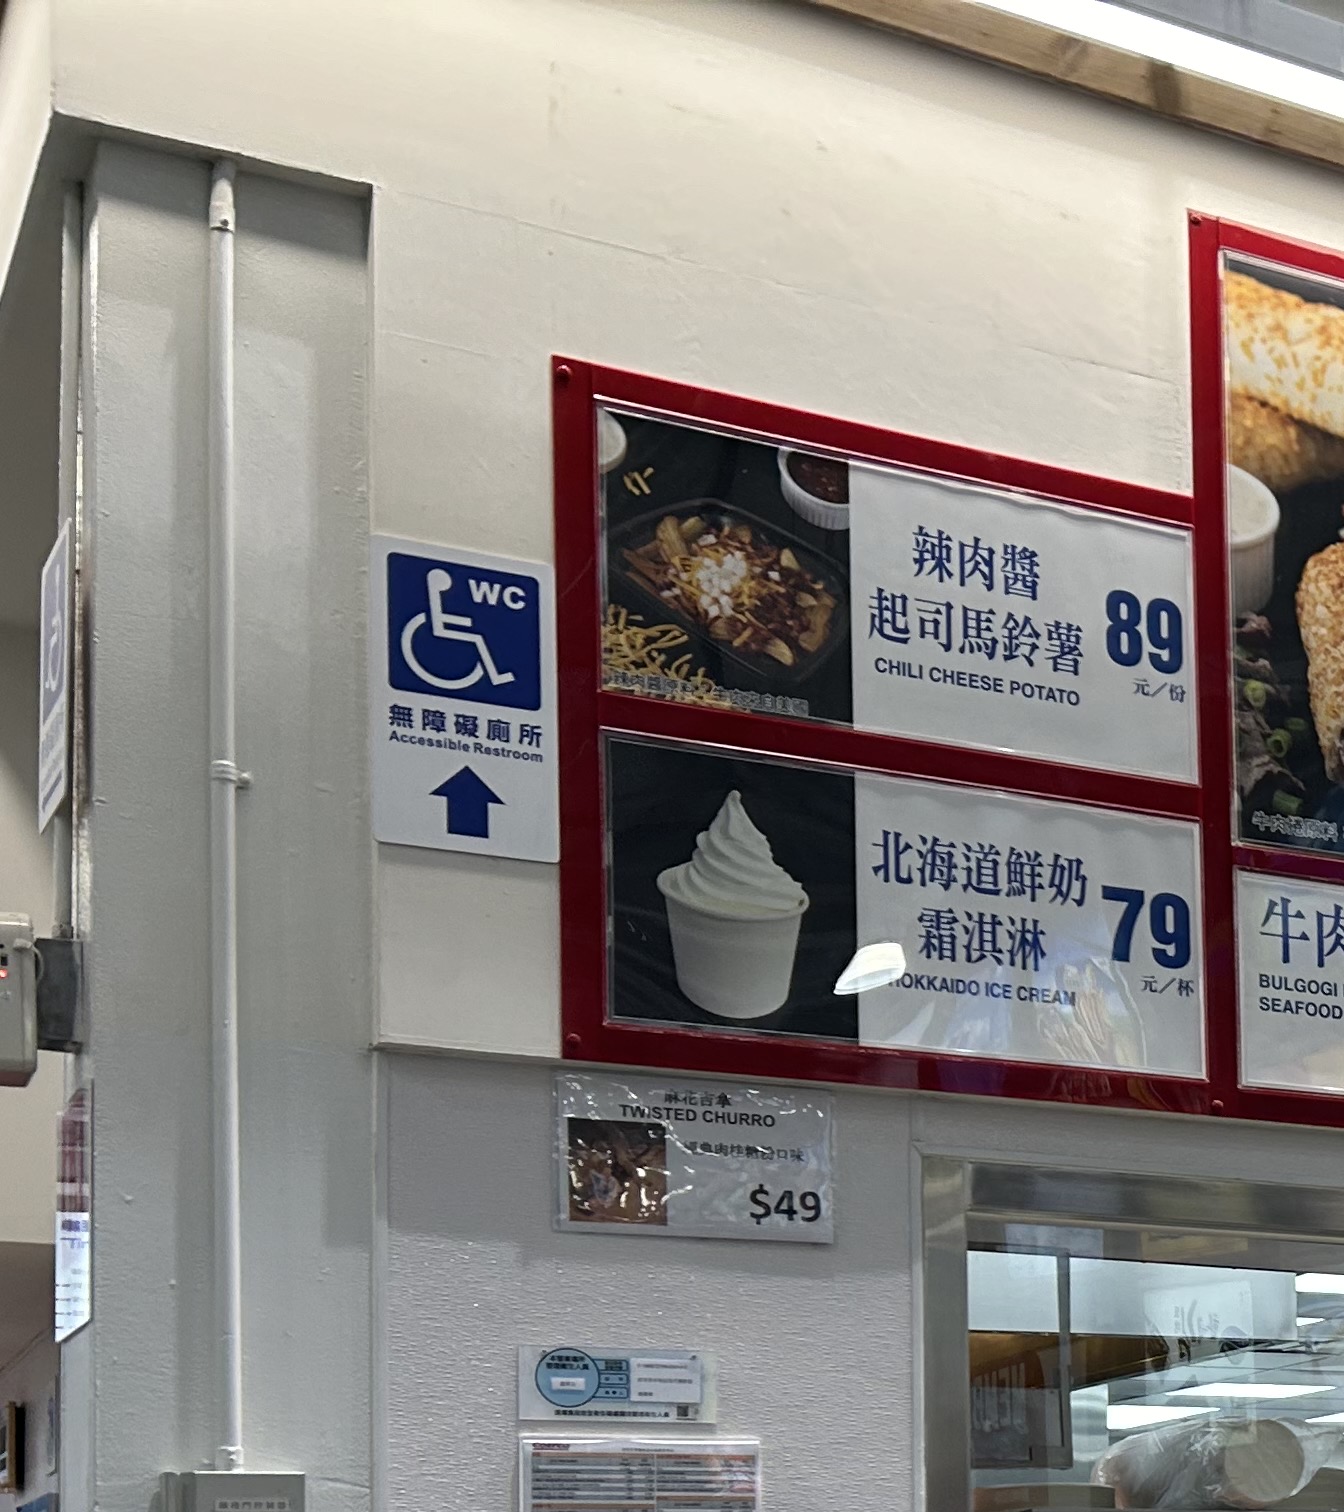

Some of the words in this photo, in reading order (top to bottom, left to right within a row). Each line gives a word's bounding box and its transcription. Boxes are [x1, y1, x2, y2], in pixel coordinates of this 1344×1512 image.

[912, 525, 1040, 601] 辣肉醬
[468, 579, 527, 610] WC
[868, 586, 1084, 677] 起司馬鈴薯
[1105, 590, 1184, 675] 89
[874, 657, 923, 680] CHILI
[929, 666, 1004, 694] CHEESE
[1010, 681, 1080, 706] POTATO
[389, 703, 542, 748] 無障礙廁所
[389, 730, 470, 752] Accessible
[473, 742, 543, 763] Restroom
[871, 829, 1088, 908] 北海道鮮奶
[917, 906, 1047, 973] 霜淇淋
[1101, 885, 1192, 970] 79
[985, 982, 1012, 1000] ICE
[1016, 986, 1076, 1007] CREAM
[1259, 973, 1338, 996] BULGOGI
[1259, 996, 1343, 1020] SEAFOOD
[619, 1104, 697, 1122] TWISTED
[702, 1110, 776, 1128] CHURRO
[750, 1184, 822, 1225] $49
